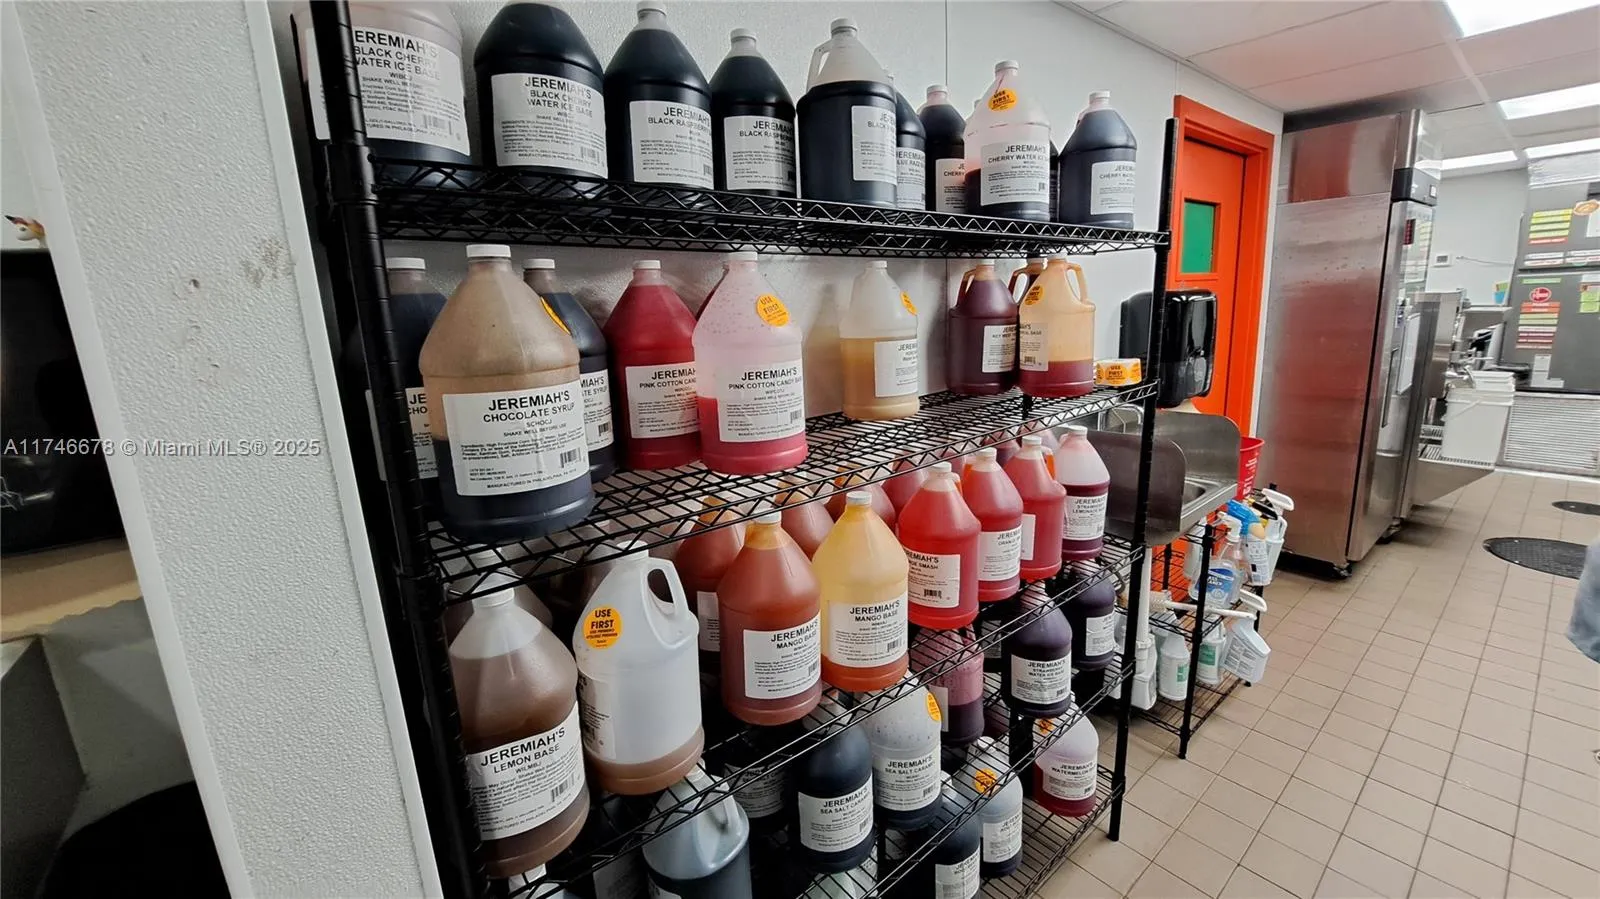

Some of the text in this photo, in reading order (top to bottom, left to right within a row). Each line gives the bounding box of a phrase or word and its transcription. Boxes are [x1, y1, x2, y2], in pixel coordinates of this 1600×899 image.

[354, 30, 438, 57] EREMIAH'S
[354, 45, 393, 59] BLACK
[394, 61, 412, 73] ICE
[524, 76, 592, 99] JEREMIAH'S
[530, 89, 592, 109] BLACK CHERRY
[526, 98, 593, 118] WATER ICE BASE
[647, 116, 675, 125] BLACK
[987, 154, 1015, 164] CHERRY
[741, 366, 798, 381] JEREMIAH'S
[581, 375, 605, 388] MIAH'S
[656, 379, 684, 388] COTTON
[746, 381, 776, 389] COTTON
[409, 393, 427, 405] JE
[488, 389, 571, 412] JEREMIAH'S
[408, 405, 428, 415] CHO
[483, 402, 576, 423] CHOCOLATE SYRUP
[487, 480, 527, 489] MANUFACTURED
[595, 608, 612, 618] USE
[849, 599, 900, 615] JEREMIAH'S
[855, 609, 898, 622] MANGO BASE
[591, 619, 614, 629] FIRST
[770, 618, 818, 642] JEREMIAH'S
[776, 637, 804, 649] MANGO
[480, 727, 566, 767] JEREMIAH'S
[493, 743, 561, 774] LEMON BASE
[887, 755, 933, 769] JEREMIAH'S
[884, 767, 897, 775] SEA
[823, 785, 868, 808] JEREMIAH'S
[834, 804, 849, 813] SALT
